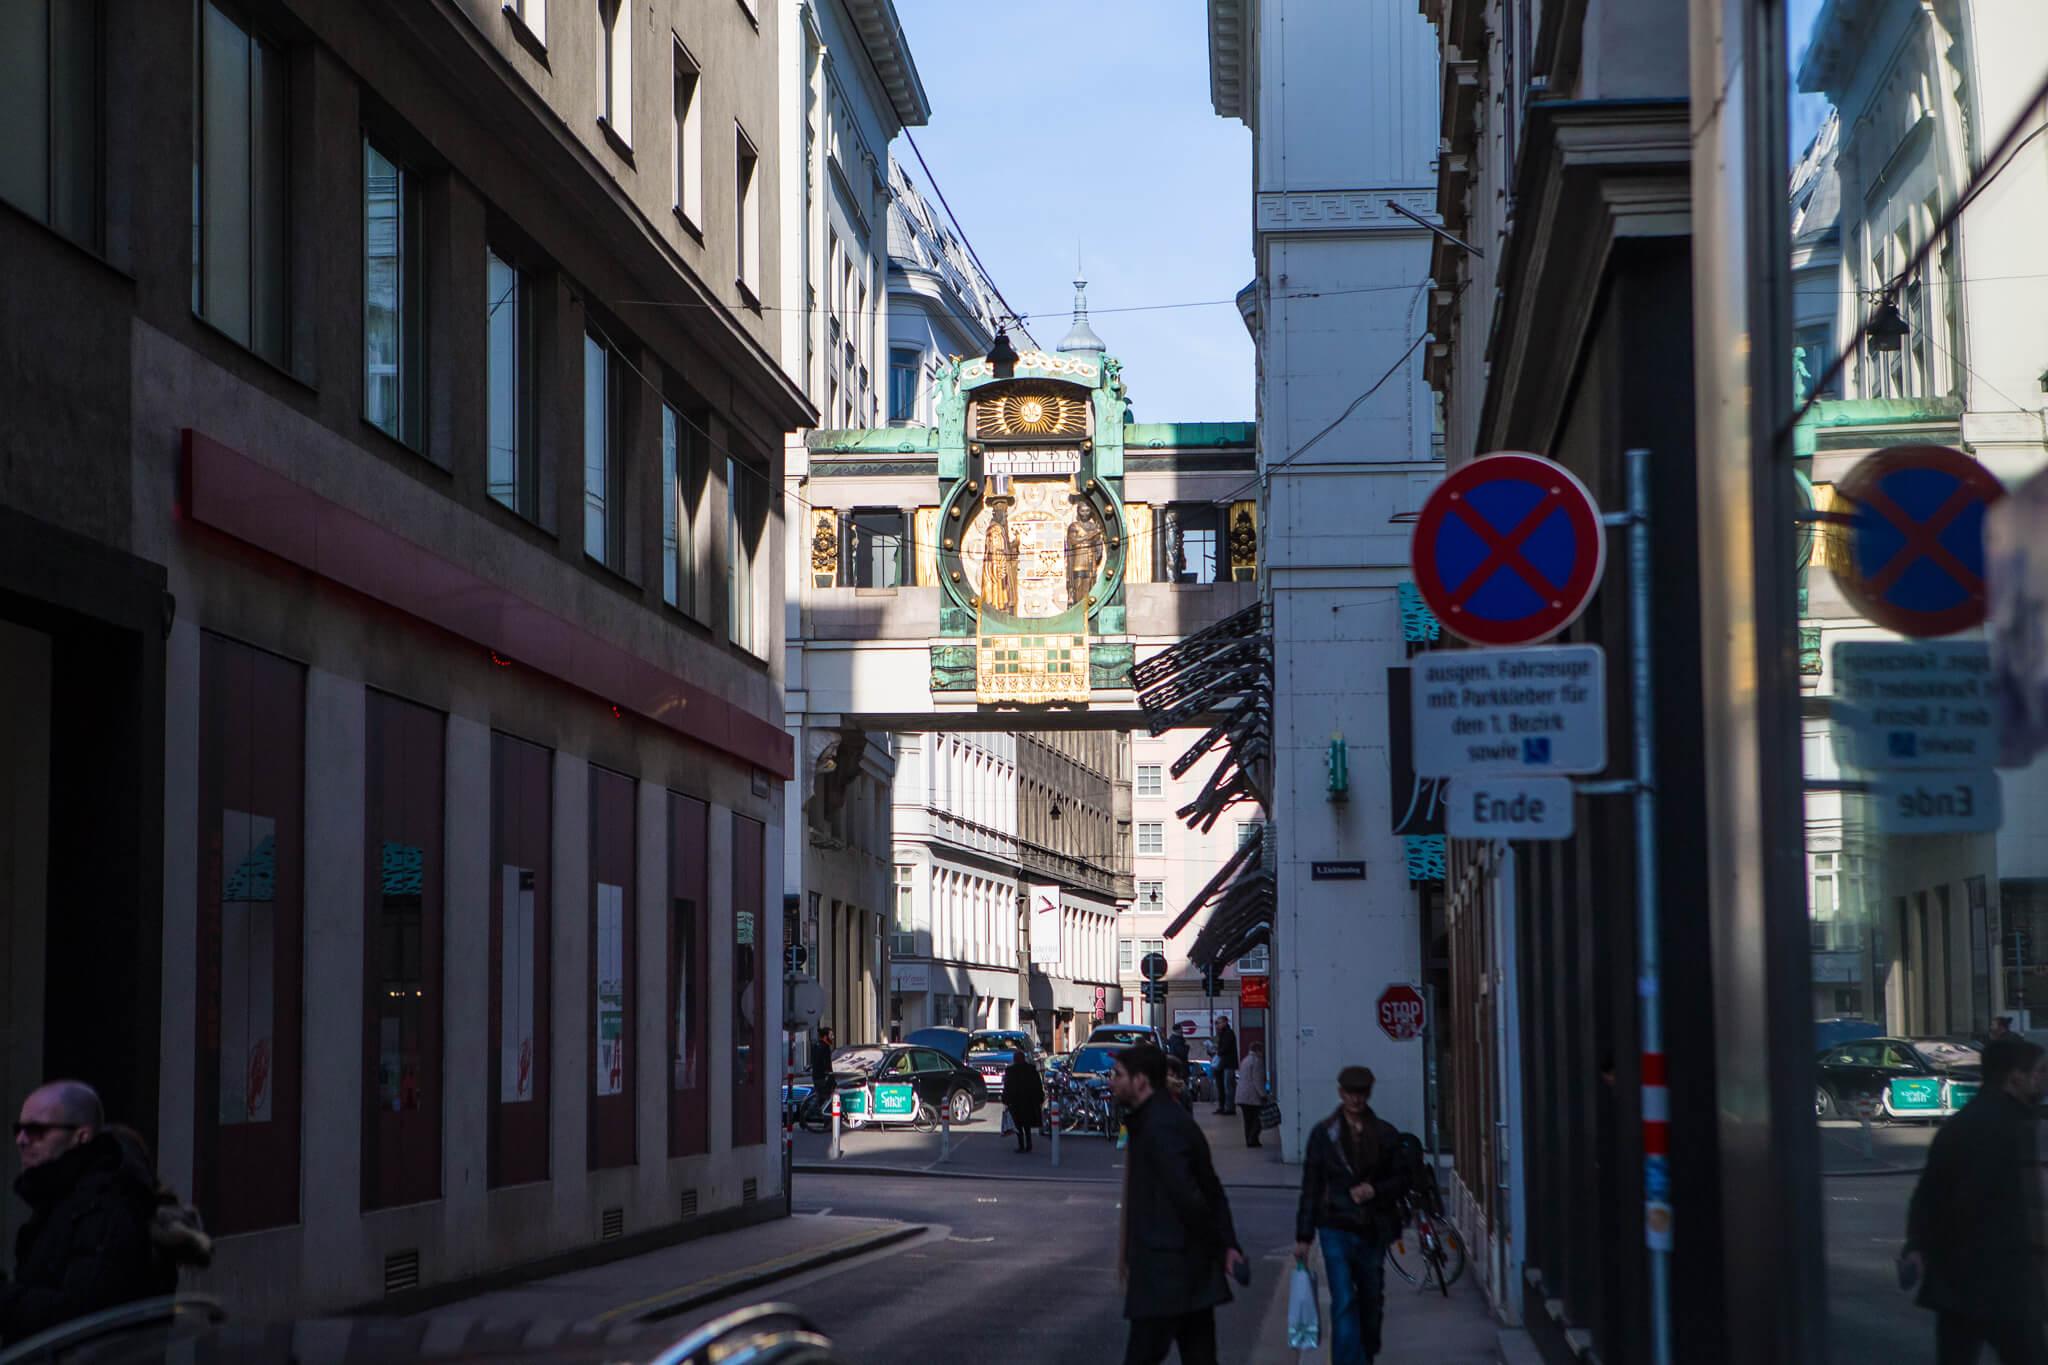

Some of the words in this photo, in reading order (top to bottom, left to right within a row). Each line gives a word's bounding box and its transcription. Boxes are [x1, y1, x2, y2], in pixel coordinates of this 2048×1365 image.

[1007, 448, 1018, 460] 15
[1025, 448, 1040, 460] 30
[1046, 447, 1060, 460] 45
[1066, 447, 1080, 460] 60
[1499, 659, 1590, 681] Fahrzeuge
[1427, 688, 1457, 708] mit
[1462, 686, 1555, 706] Parkkleber
[1559, 683, 1589, 703] für
[1452, 716, 1485, 736] den
[1508, 711, 1565, 733] Bezirk
[1467, 740, 1518, 761] sowie
[1473, 793, 1546, 824] Ende
[1095, 986, 1106, 1020] BAR
[1381, 1000, 1421, 1024] STOP
